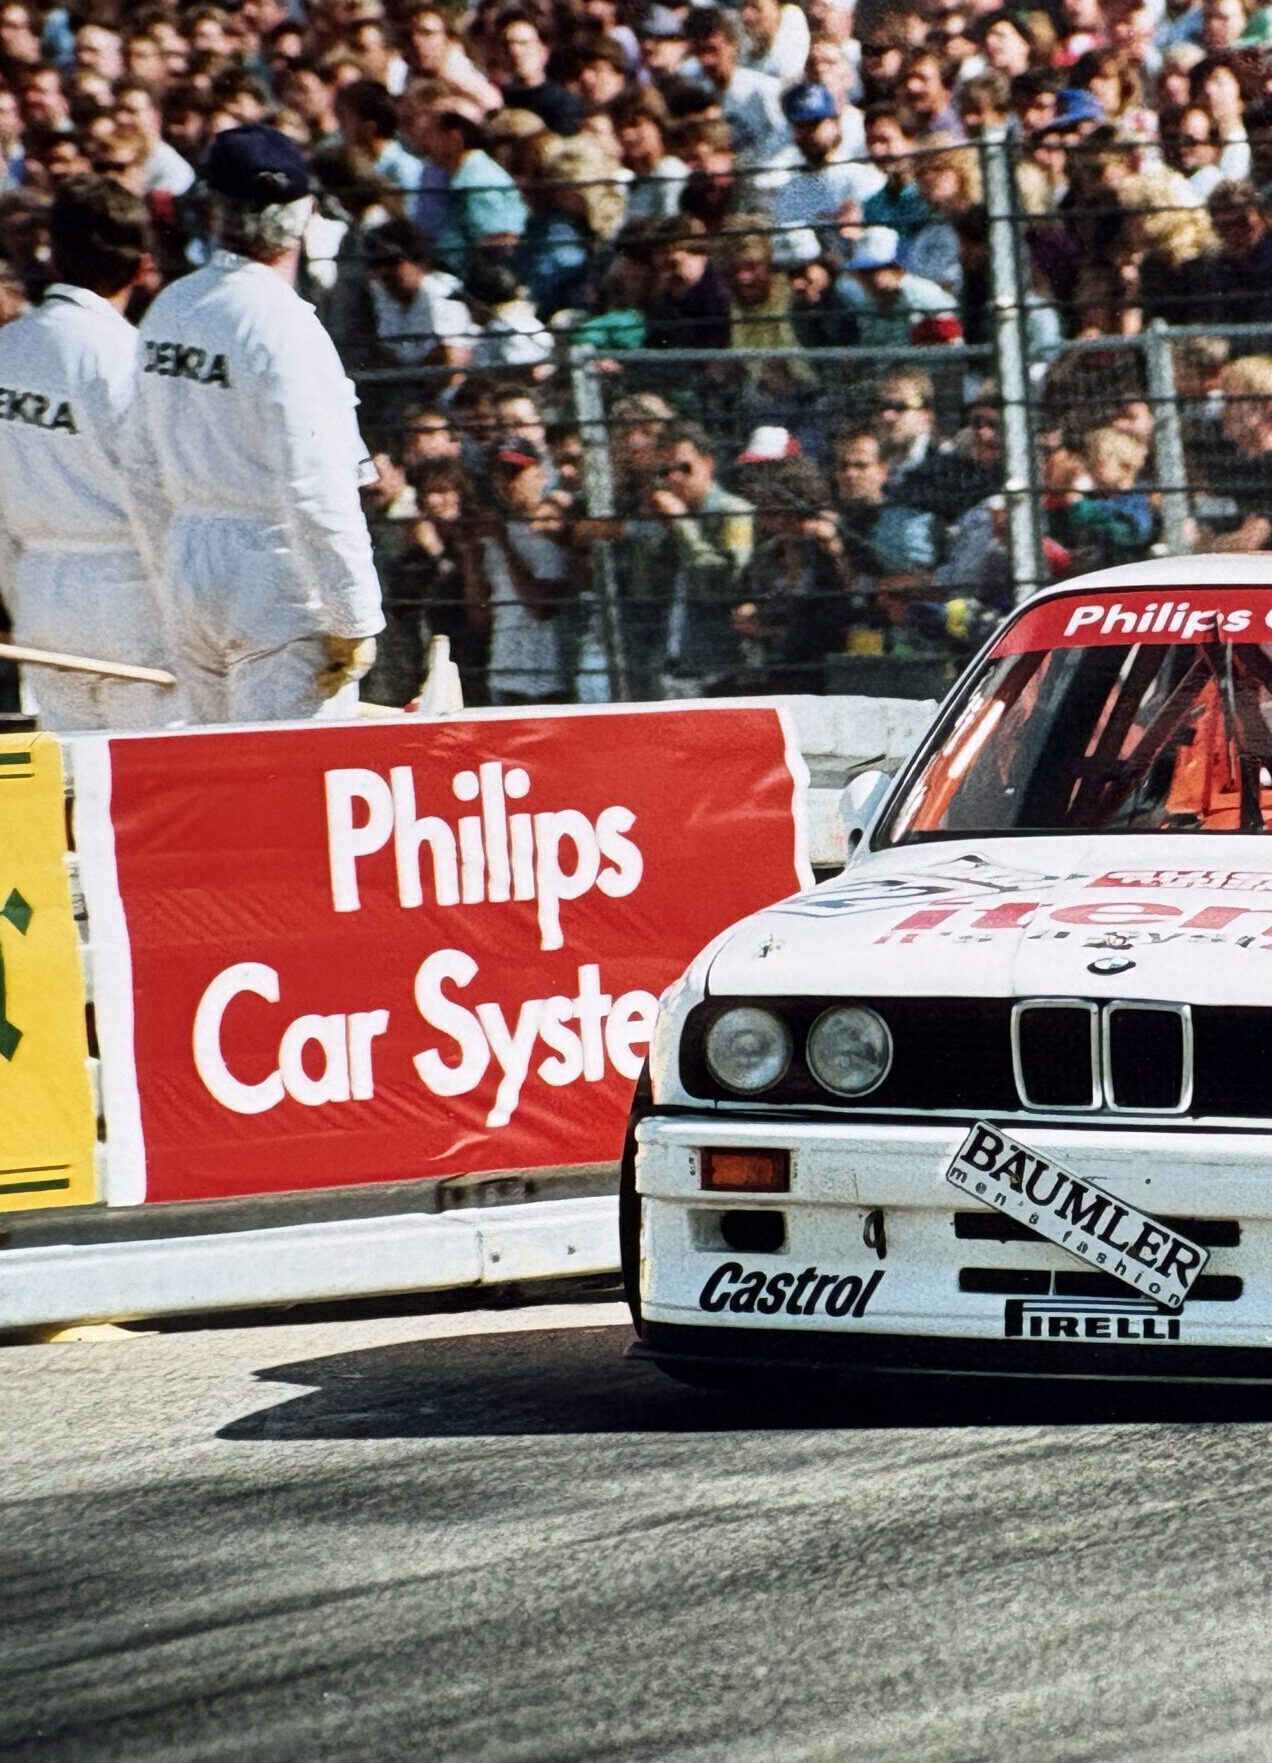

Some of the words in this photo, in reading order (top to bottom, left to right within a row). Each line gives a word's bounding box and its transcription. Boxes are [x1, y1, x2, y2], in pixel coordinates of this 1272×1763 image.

[1063, 601, 1253, 638] Philips
[325, 762, 644, 951] Philips
[193, 962, 388, 1114] Car
[960, 1126, 1200, 1288] BÄUMLER
[699, 1262, 885, 1318] Castrol
[1004, 1299, 1183, 1339] PIRELLI
